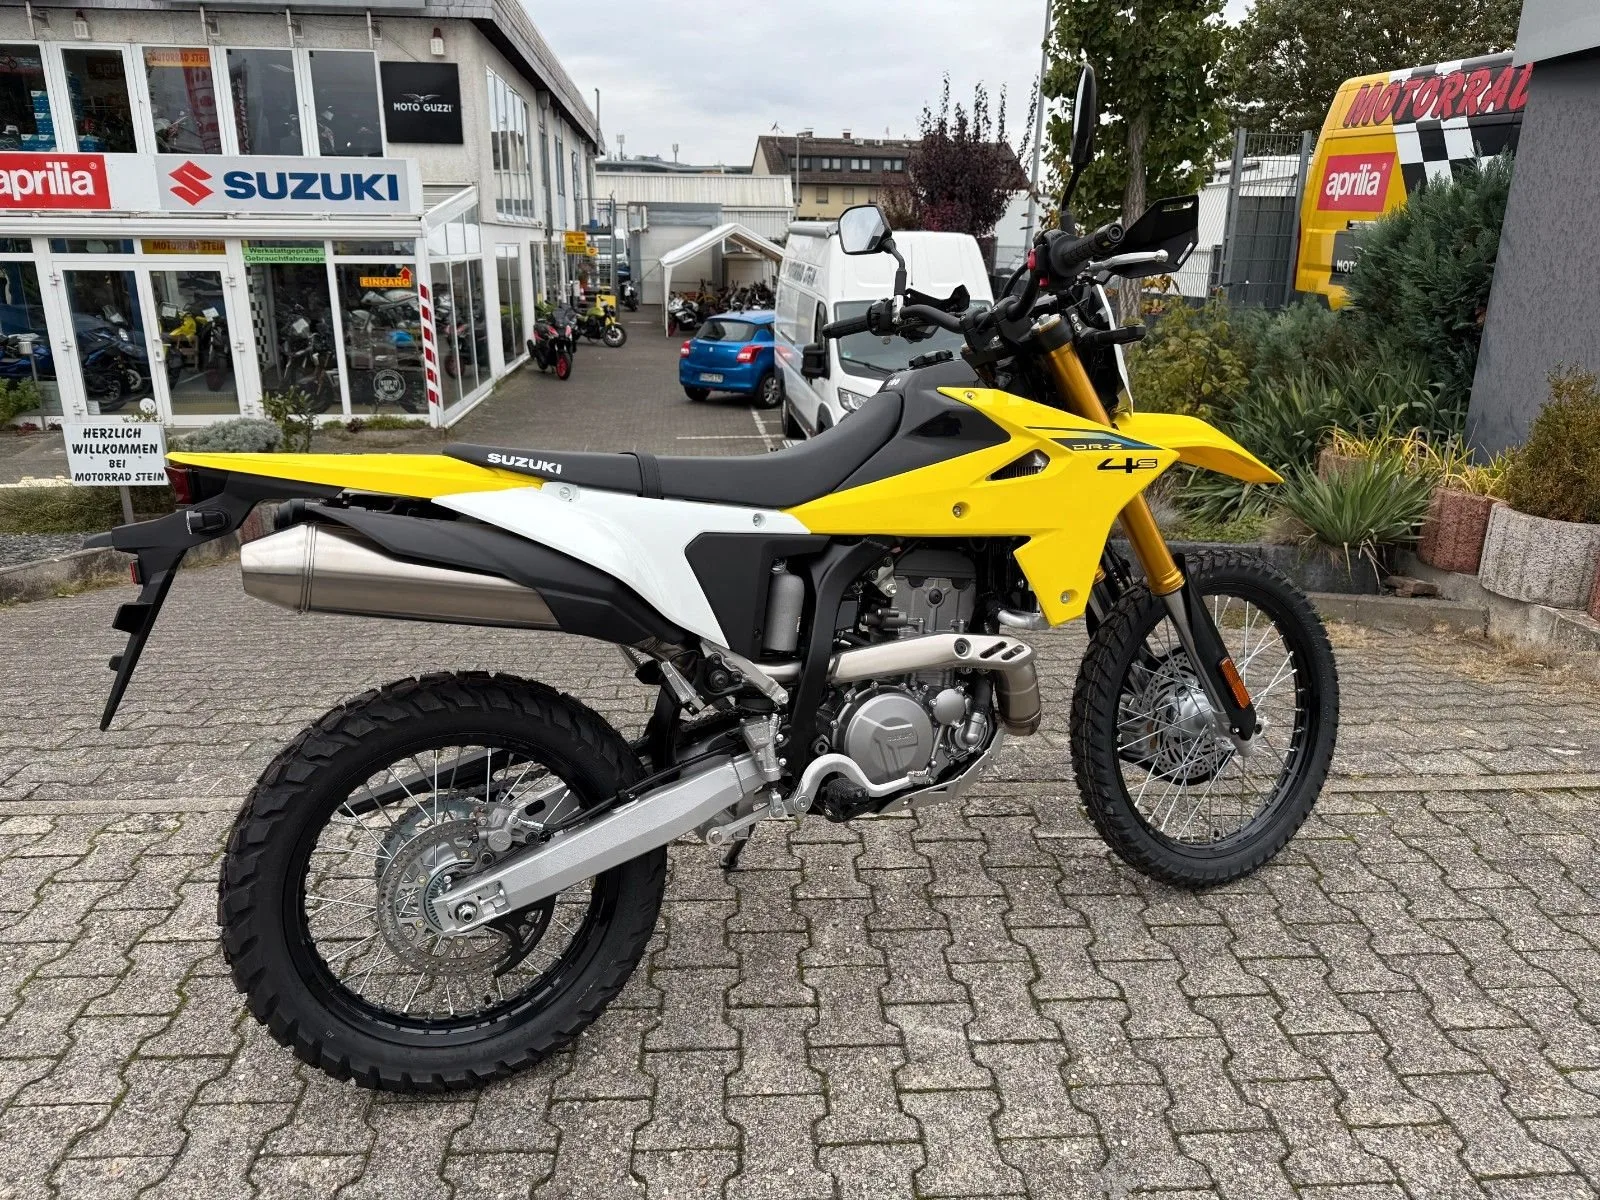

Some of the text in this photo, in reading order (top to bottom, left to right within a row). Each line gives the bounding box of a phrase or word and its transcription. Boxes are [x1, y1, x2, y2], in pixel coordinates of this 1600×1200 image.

[393, 102, 452, 113] MOTO GUZZI
[0, 162, 95, 201] aprilia
[223, 171, 400, 201] SUZUKI
[1325, 163, 1381, 202] aprilia
[249, 247, 319, 255] Werkstattgeprüfte
[245, 255, 325, 263] Gebrauchtfahrzeuge
[1336, 259, 1358, 274] MOT
[362, 278, 410, 286] EINGANG
[83, 428, 142, 439] HERZLICH
[72, 443, 158, 455] WILLKOMMEN
[1072, 443, 1123, 451] DR-Z
[109, 459, 126, 468] BEI
[487, 453, 562, 475] SUZUKI
[75, 472, 165, 482] MOTORRAD STEIN
